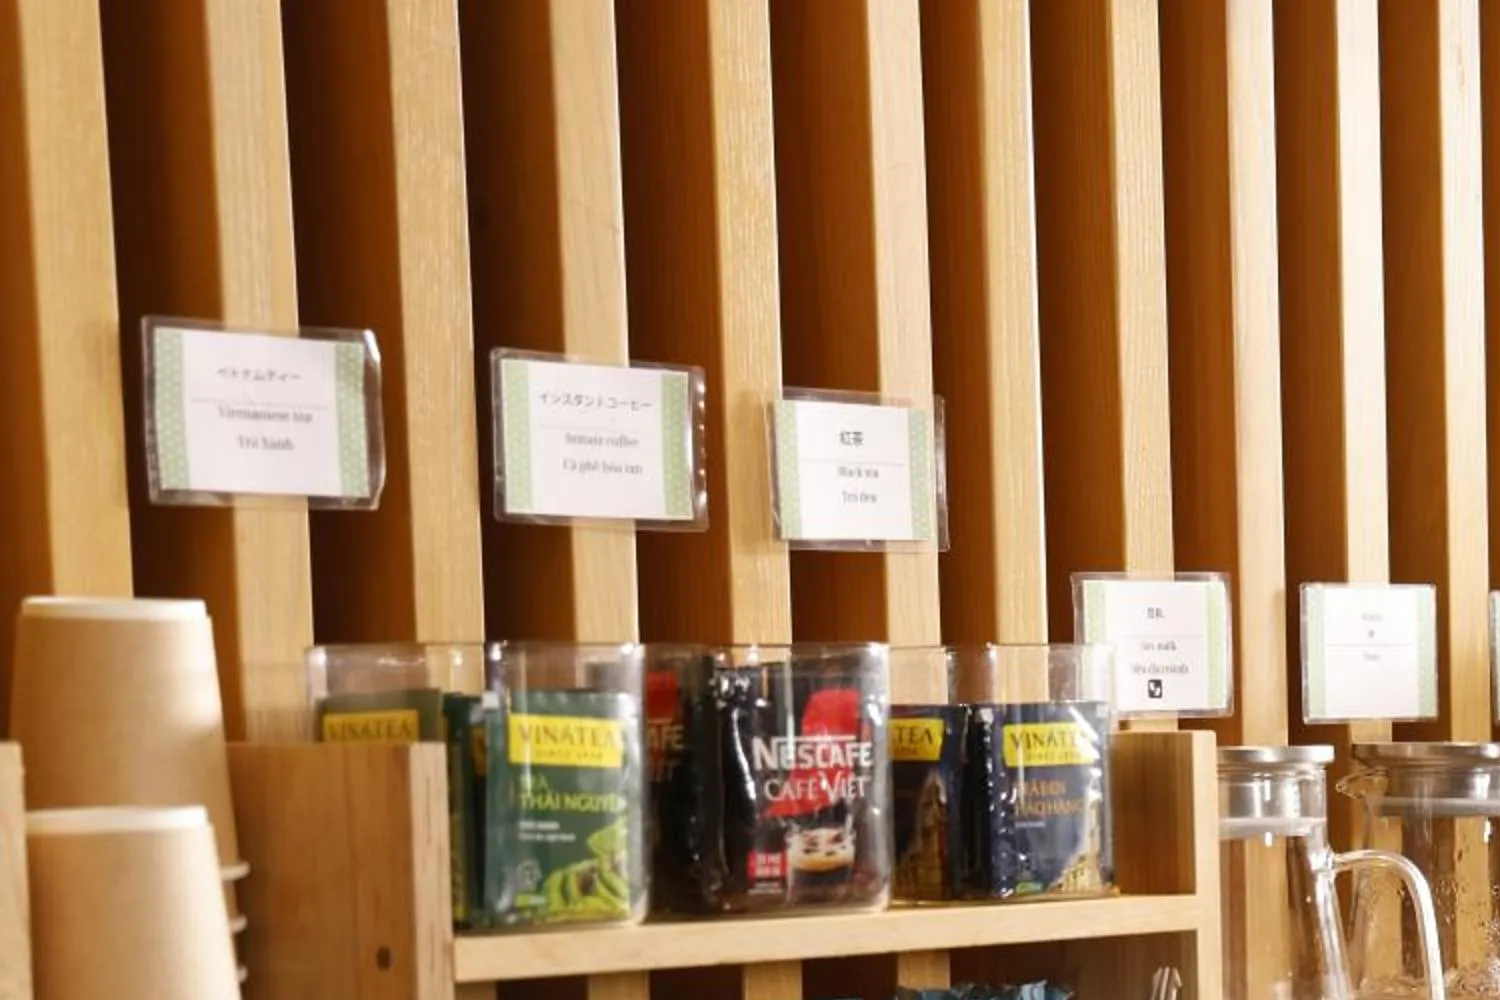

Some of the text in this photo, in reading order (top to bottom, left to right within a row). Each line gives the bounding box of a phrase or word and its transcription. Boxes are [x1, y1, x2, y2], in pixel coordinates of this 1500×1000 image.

[540, 392, 653, 411] インスタントコーヒー
[839, 431, 864, 448] 紅茶
[517, 723, 617, 747] VINATEA
[1009, 729, 1090, 750] VINAT
